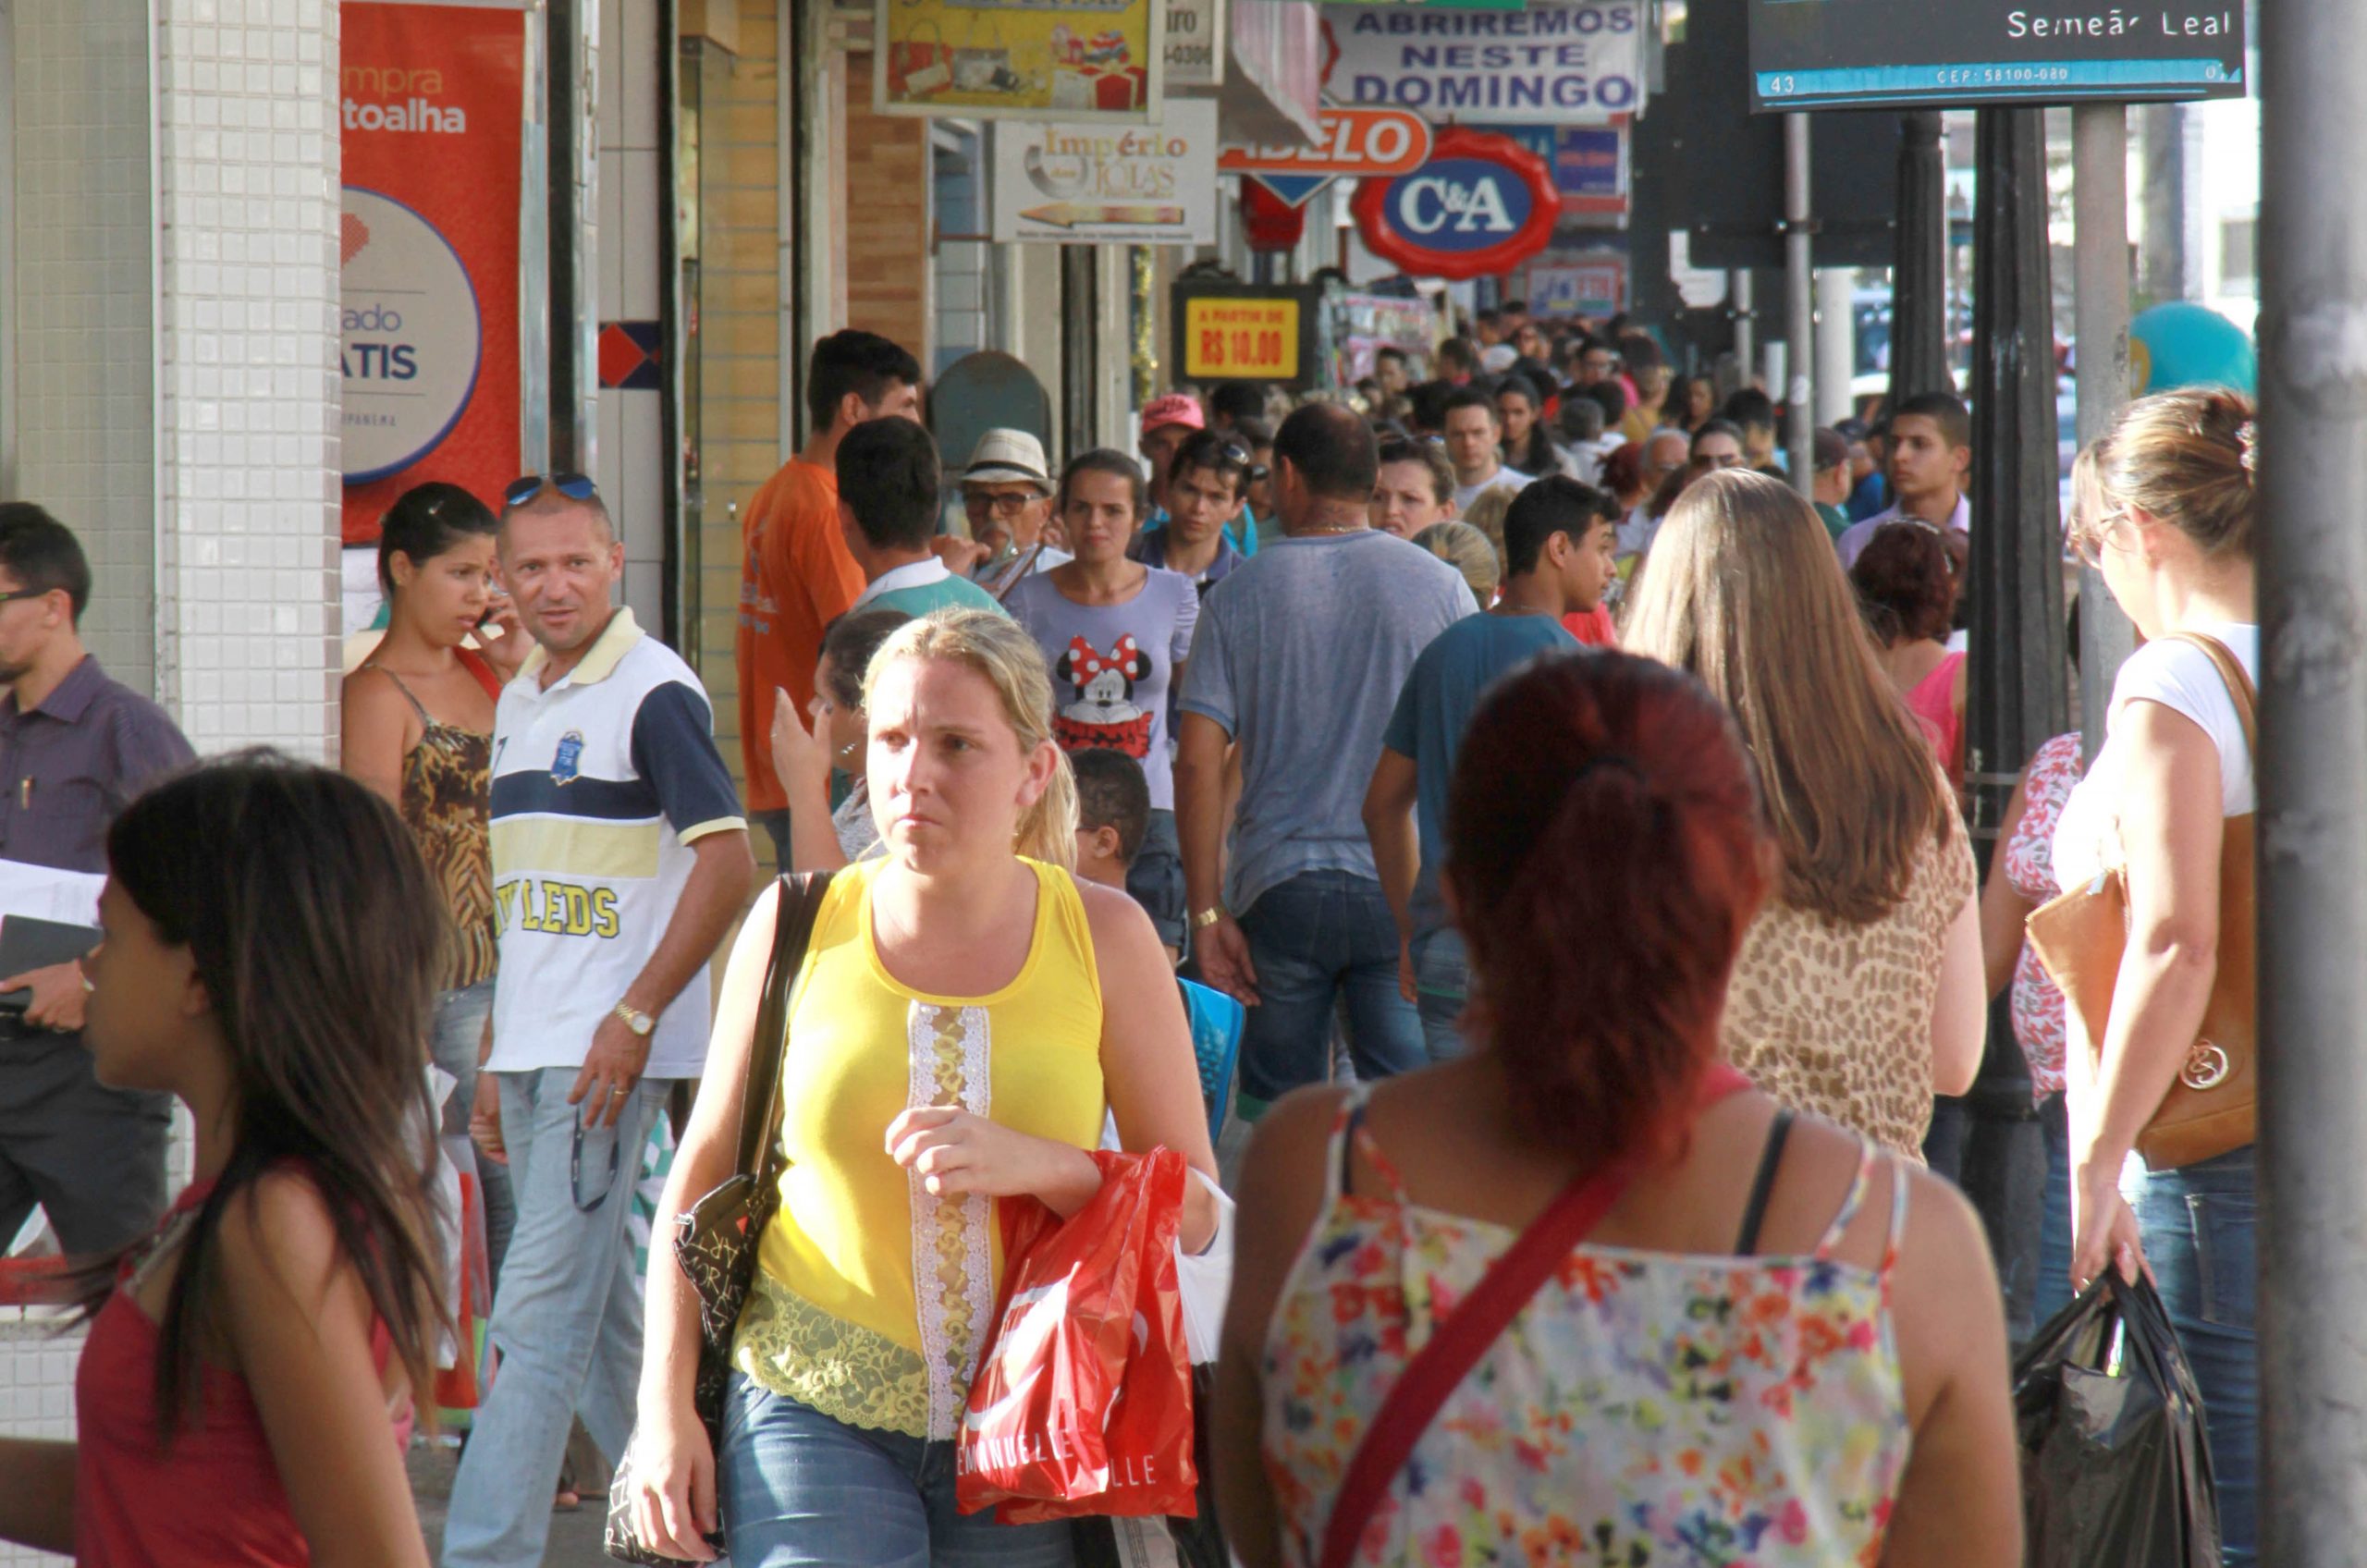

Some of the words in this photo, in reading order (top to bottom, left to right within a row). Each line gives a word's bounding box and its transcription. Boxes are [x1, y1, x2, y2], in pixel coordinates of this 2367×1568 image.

[1353, 6, 1636, 36] ABRIREMOS
[2162, 10, 2229, 36] Leal
[1400, 44, 1588, 68] NESTE
[341, 66, 443, 101] mpra
[1353, 74, 1636, 109] DOMINGO
[1771, 75, 1795, 93] 43
[342, 97, 466, 134] toalha
[1045, 129, 1188, 166] Império
[1400, 176, 1515, 234] C&A
